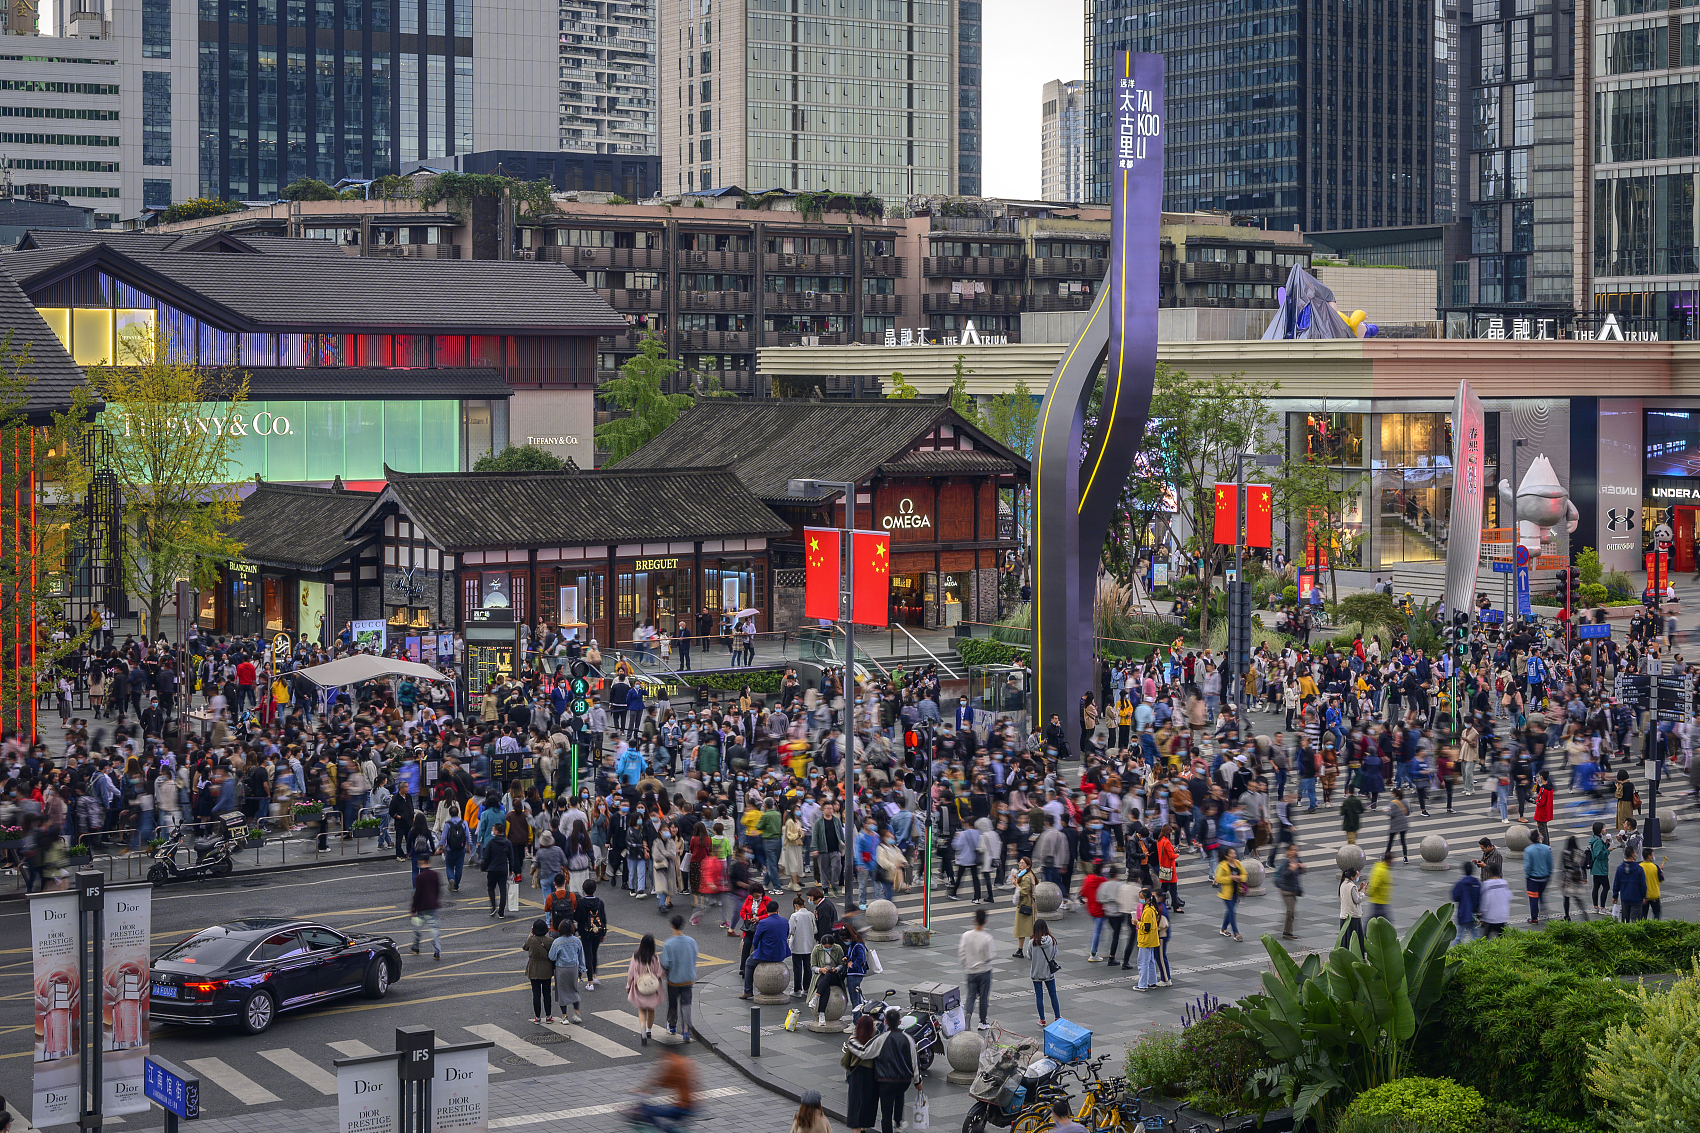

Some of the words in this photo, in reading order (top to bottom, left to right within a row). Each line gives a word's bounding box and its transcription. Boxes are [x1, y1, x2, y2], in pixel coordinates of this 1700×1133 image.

[1136, 89, 1152, 112] TAI
[1119, 89, 1135, 158] 太古里
[1137, 113, 1159, 136] KOO
[1136, 136, 1146, 159] LI
[1119, 159, 1134, 168] 成都
[942, 336, 958, 345] THE
[961, 320, 1007, 345] ATRIUM
[1488, 318, 1554, 340] 晶融汇
[1574, 330, 1595, 341] THE
[1598, 313, 1659, 341] ATRIUM
[884, 328, 930, 347] 晶融汇
[1652, 487, 1690, 498] UNDER
[882, 514, 931, 529] OMEGA
[635, 558, 679, 571] BREGUET
[354, 621, 384, 629] GUCCI
[86, 887, 99, 897] IFS
[116, 902, 139, 913] Dior
[44, 909, 67, 921] Dior
[110, 929, 145, 938] PRESTIGE
[39, 937, 74, 947] PRESTIGE
[412, 1049, 429, 1062] IFS
[445, 1067, 474, 1082] Dior
[115, 1082, 139, 1094] Dior
[354, 1079, 383, 1095] Dior
[45, 1092, 68, 1104] Dior
[448, 1096, 470, 1106] DIOR
[359, 1109, 380, 1120] DIOR
[437, 1103, 481, 1116] PRESTIGE
[347, 1115, 392, 1130] PRESTIGE
